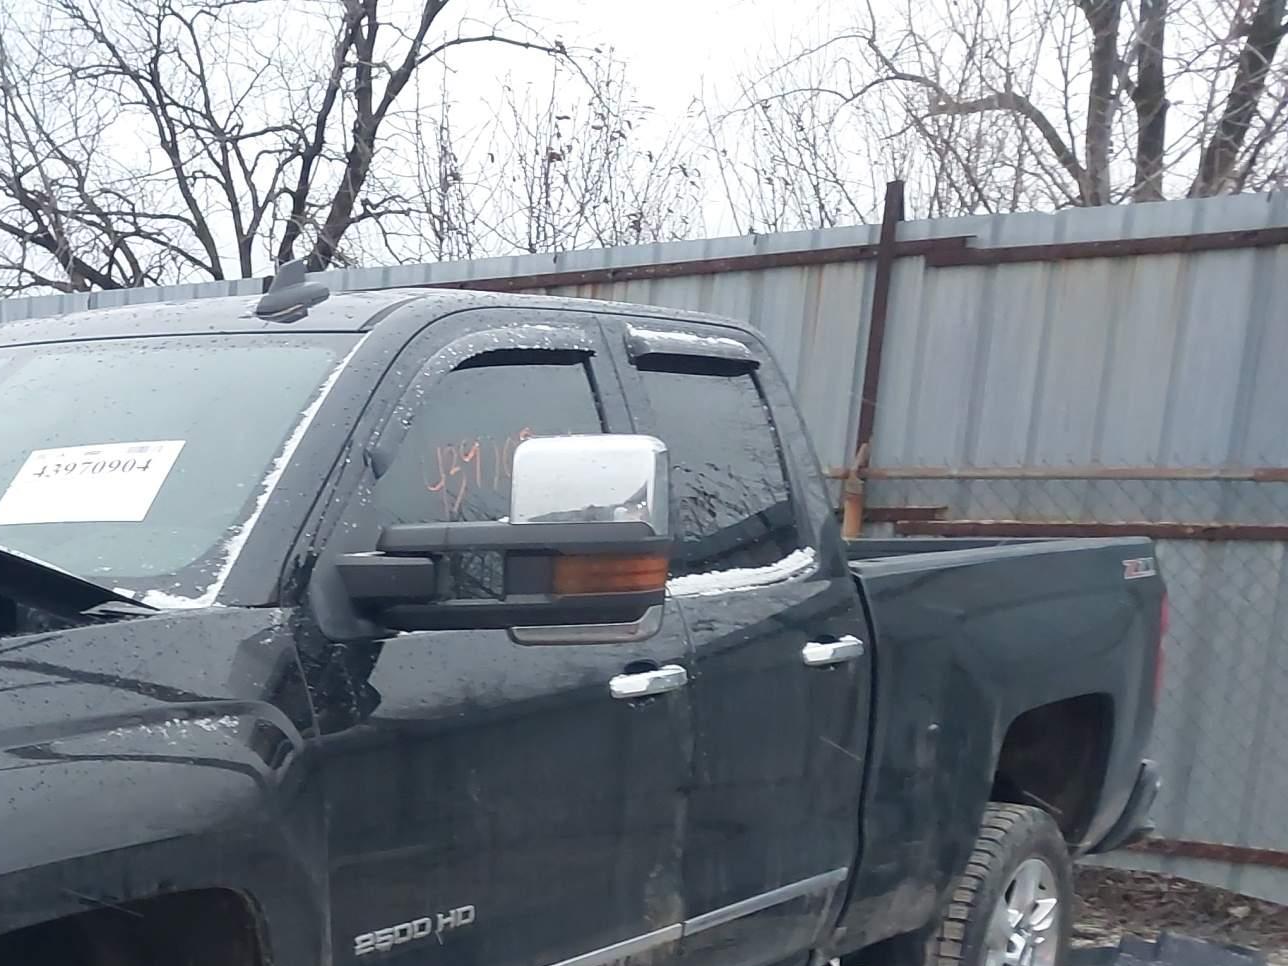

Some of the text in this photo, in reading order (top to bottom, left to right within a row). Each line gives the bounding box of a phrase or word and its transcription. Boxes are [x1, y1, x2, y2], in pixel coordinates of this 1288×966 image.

[32, 457, 154, 479] 43970904
[354, 904, 476, 956] 2500 HD
